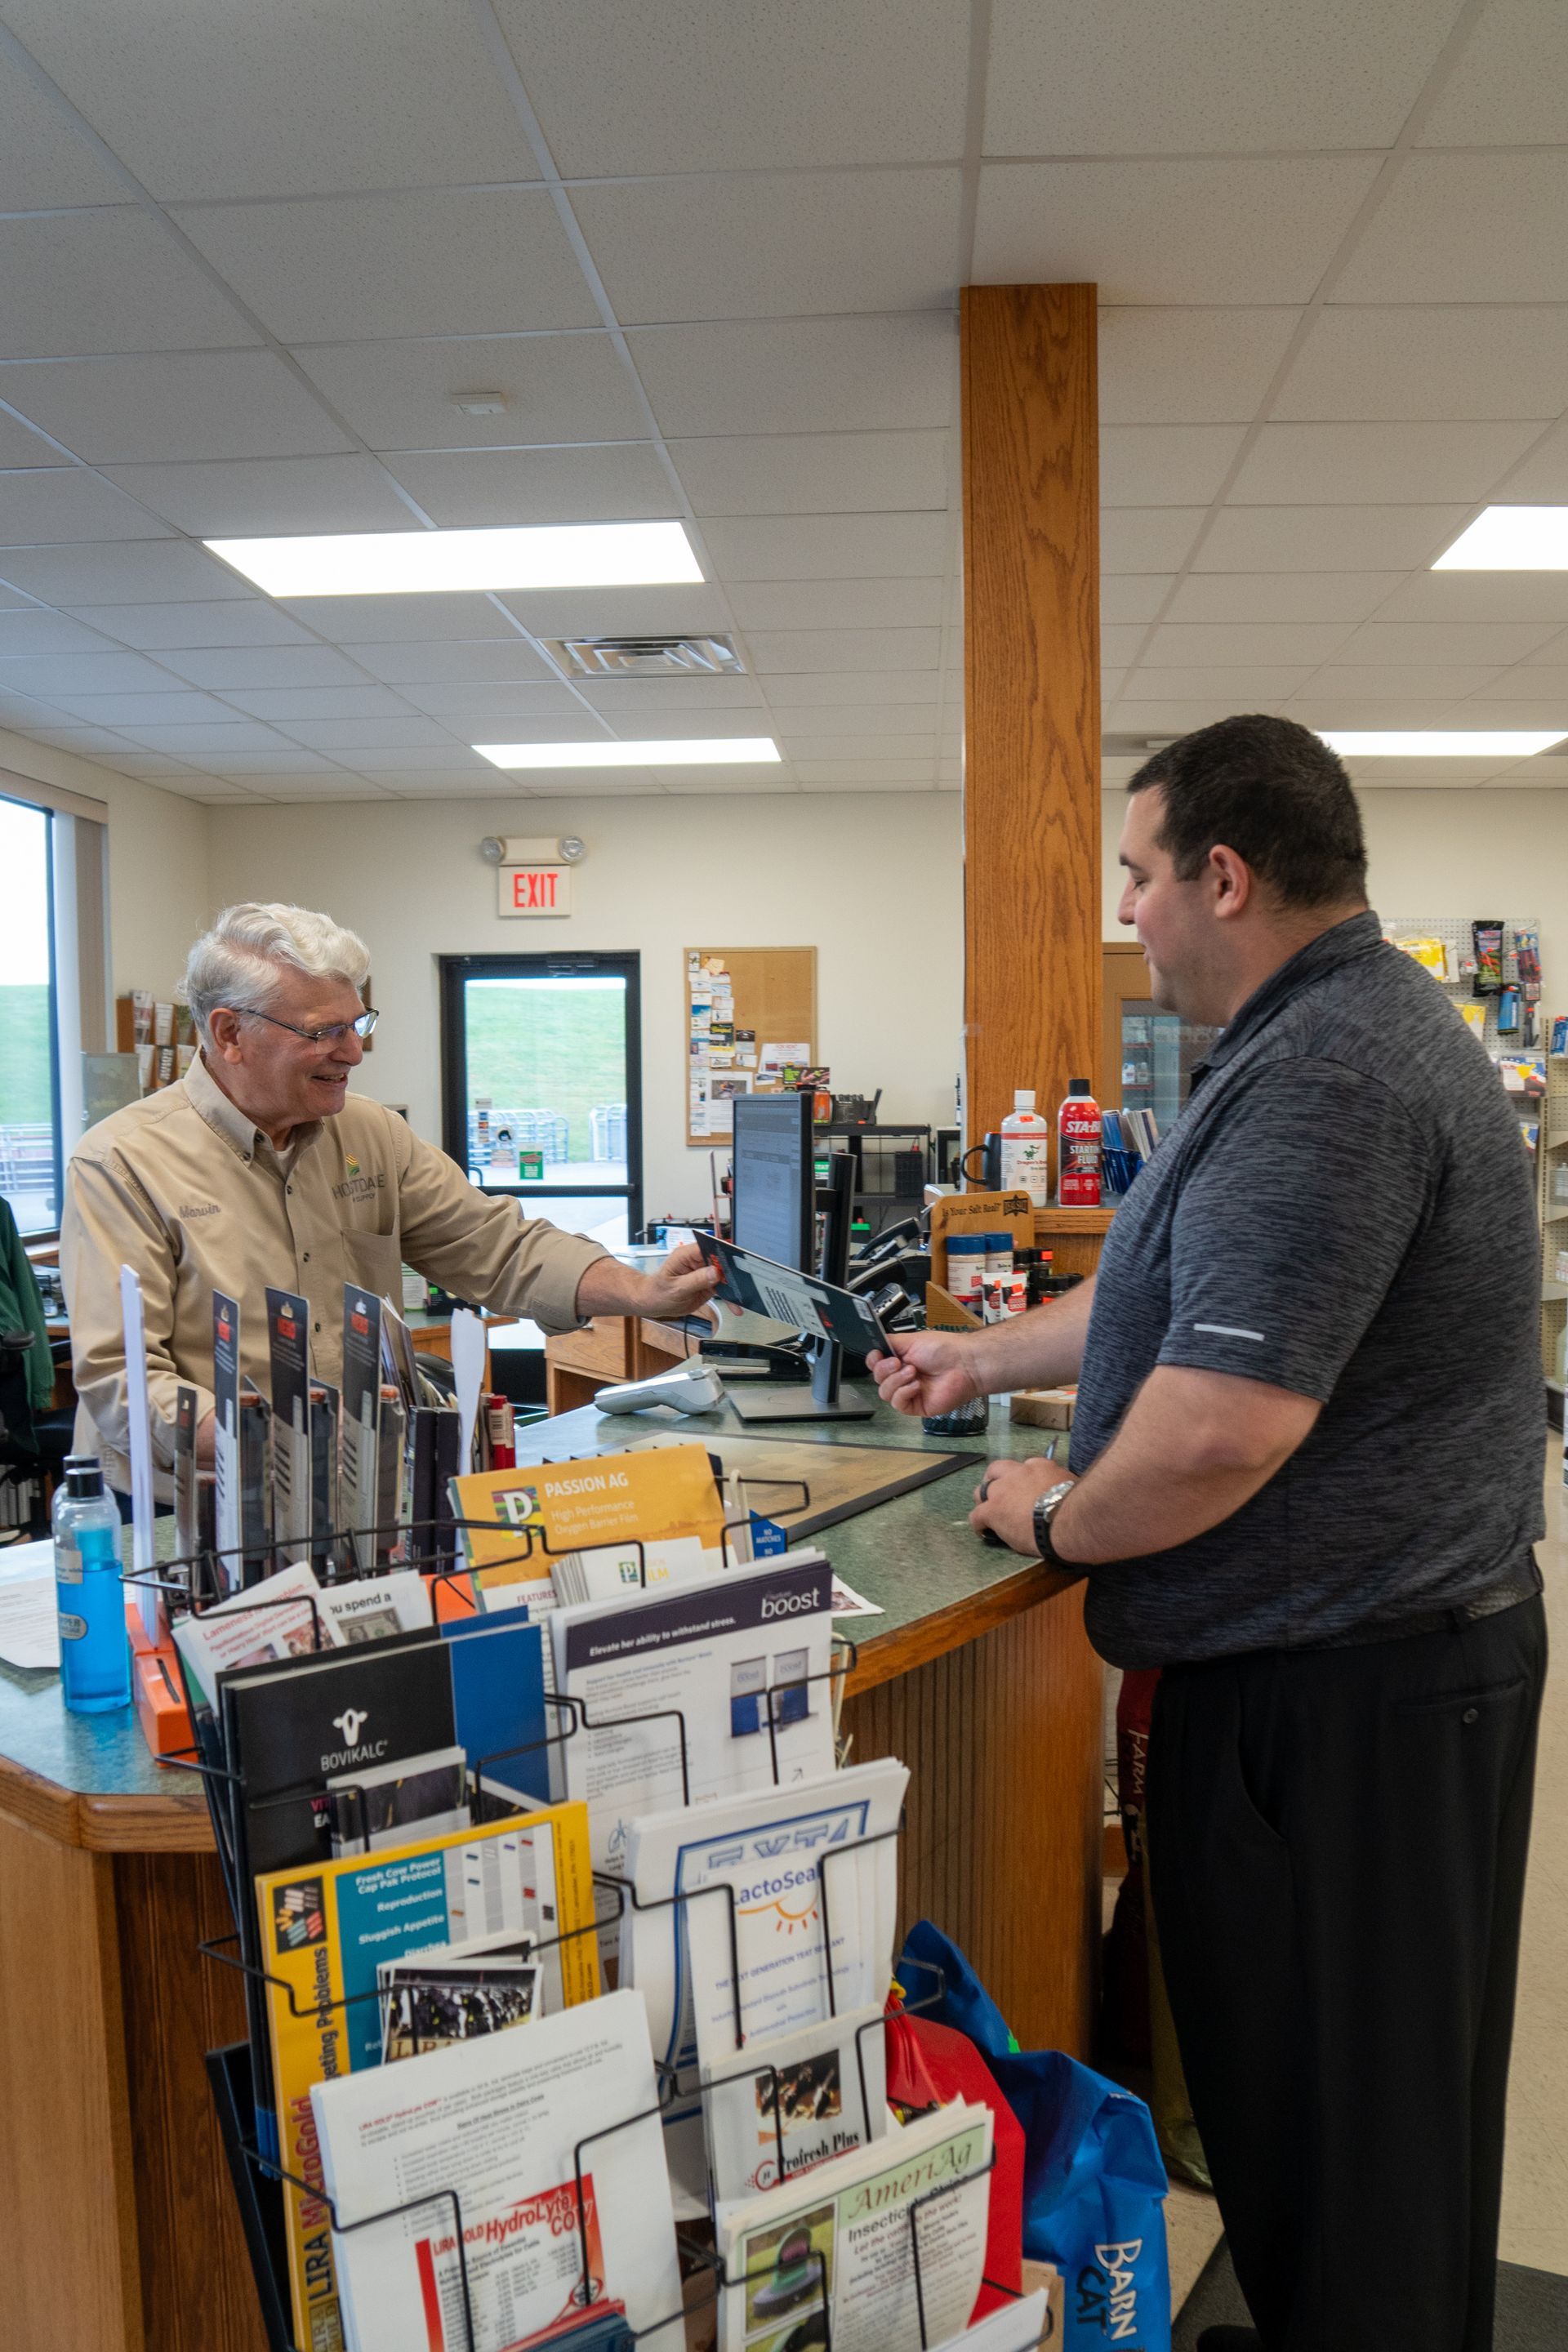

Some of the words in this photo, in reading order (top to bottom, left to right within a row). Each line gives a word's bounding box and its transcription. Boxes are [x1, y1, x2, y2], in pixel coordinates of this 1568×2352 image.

[513, 873, 558, 908] EXIT
[1077, 1155, 1098, 1165] FLUID
[179, 1202, 221, 1219] Marvin
[949, 1205, 967, 1216] Your
[969, 1204, 982, 1214] Salt
[544, 1475, 606, 1498] PASSION
[608, 1472, 629, 1488] AG
[550, 1508, 573, 1522] High
[575, 1499, 635, 1517] Performance
[554, 1519, 590, 1535] Oxygen
[589, 1516, 618, 1529] Barrier
[620, 1512, 639, 1525] Film
[755, 1535, 782, 1544] MATCHES
[647, 1567, 670, 1582] ILM
[344, 1597, 382, 1613] spend
[384, 1593, 392, 1602] a
[516, 1589, 557, 1605] FEATURES
[760, 1587, 820, 1619] boost
[589, 1642, 621, 1658] Elevate
[620, 1638, 635, 1650] her
[635, 1632, 662, 1647] ability
[662, 1630, 671, 1640] to
[670, 1620, 710, 1638] withstand
[710, 1616, 737, 1630] stress.
[354, 1871, 385, 1886] Fresh
[385, 1865, 408, 1878] Cow
[408, 1857, 442, 1873] Power
[357, 1883, 379, 1895] Cap
[379, 1878, 399, 1890] Pak
[400, 1865, 443, 1884] Protocol
[732, 1864, 820, 1906] actoSea
[376, 1888, 443, 1913] Reproduction
[358, 1925, 403, 1945] Sluggish
[403, 1914, 446, 1934] Appetite
[832, 2130, 859, 2152] Plus
[847, 2141, 973, 2220] AmeriAg
[434, 2236, 456, 2256] LIRA
[462, 2224, 484, 2244] OLD
[484, 2189, 570, 2245] HydroLyte
[302, 2230, 332, 2301] LIRA
[1076, 2265, 1107, 2336] CAT
[1094, 2237, 1143, 2341] BARN
